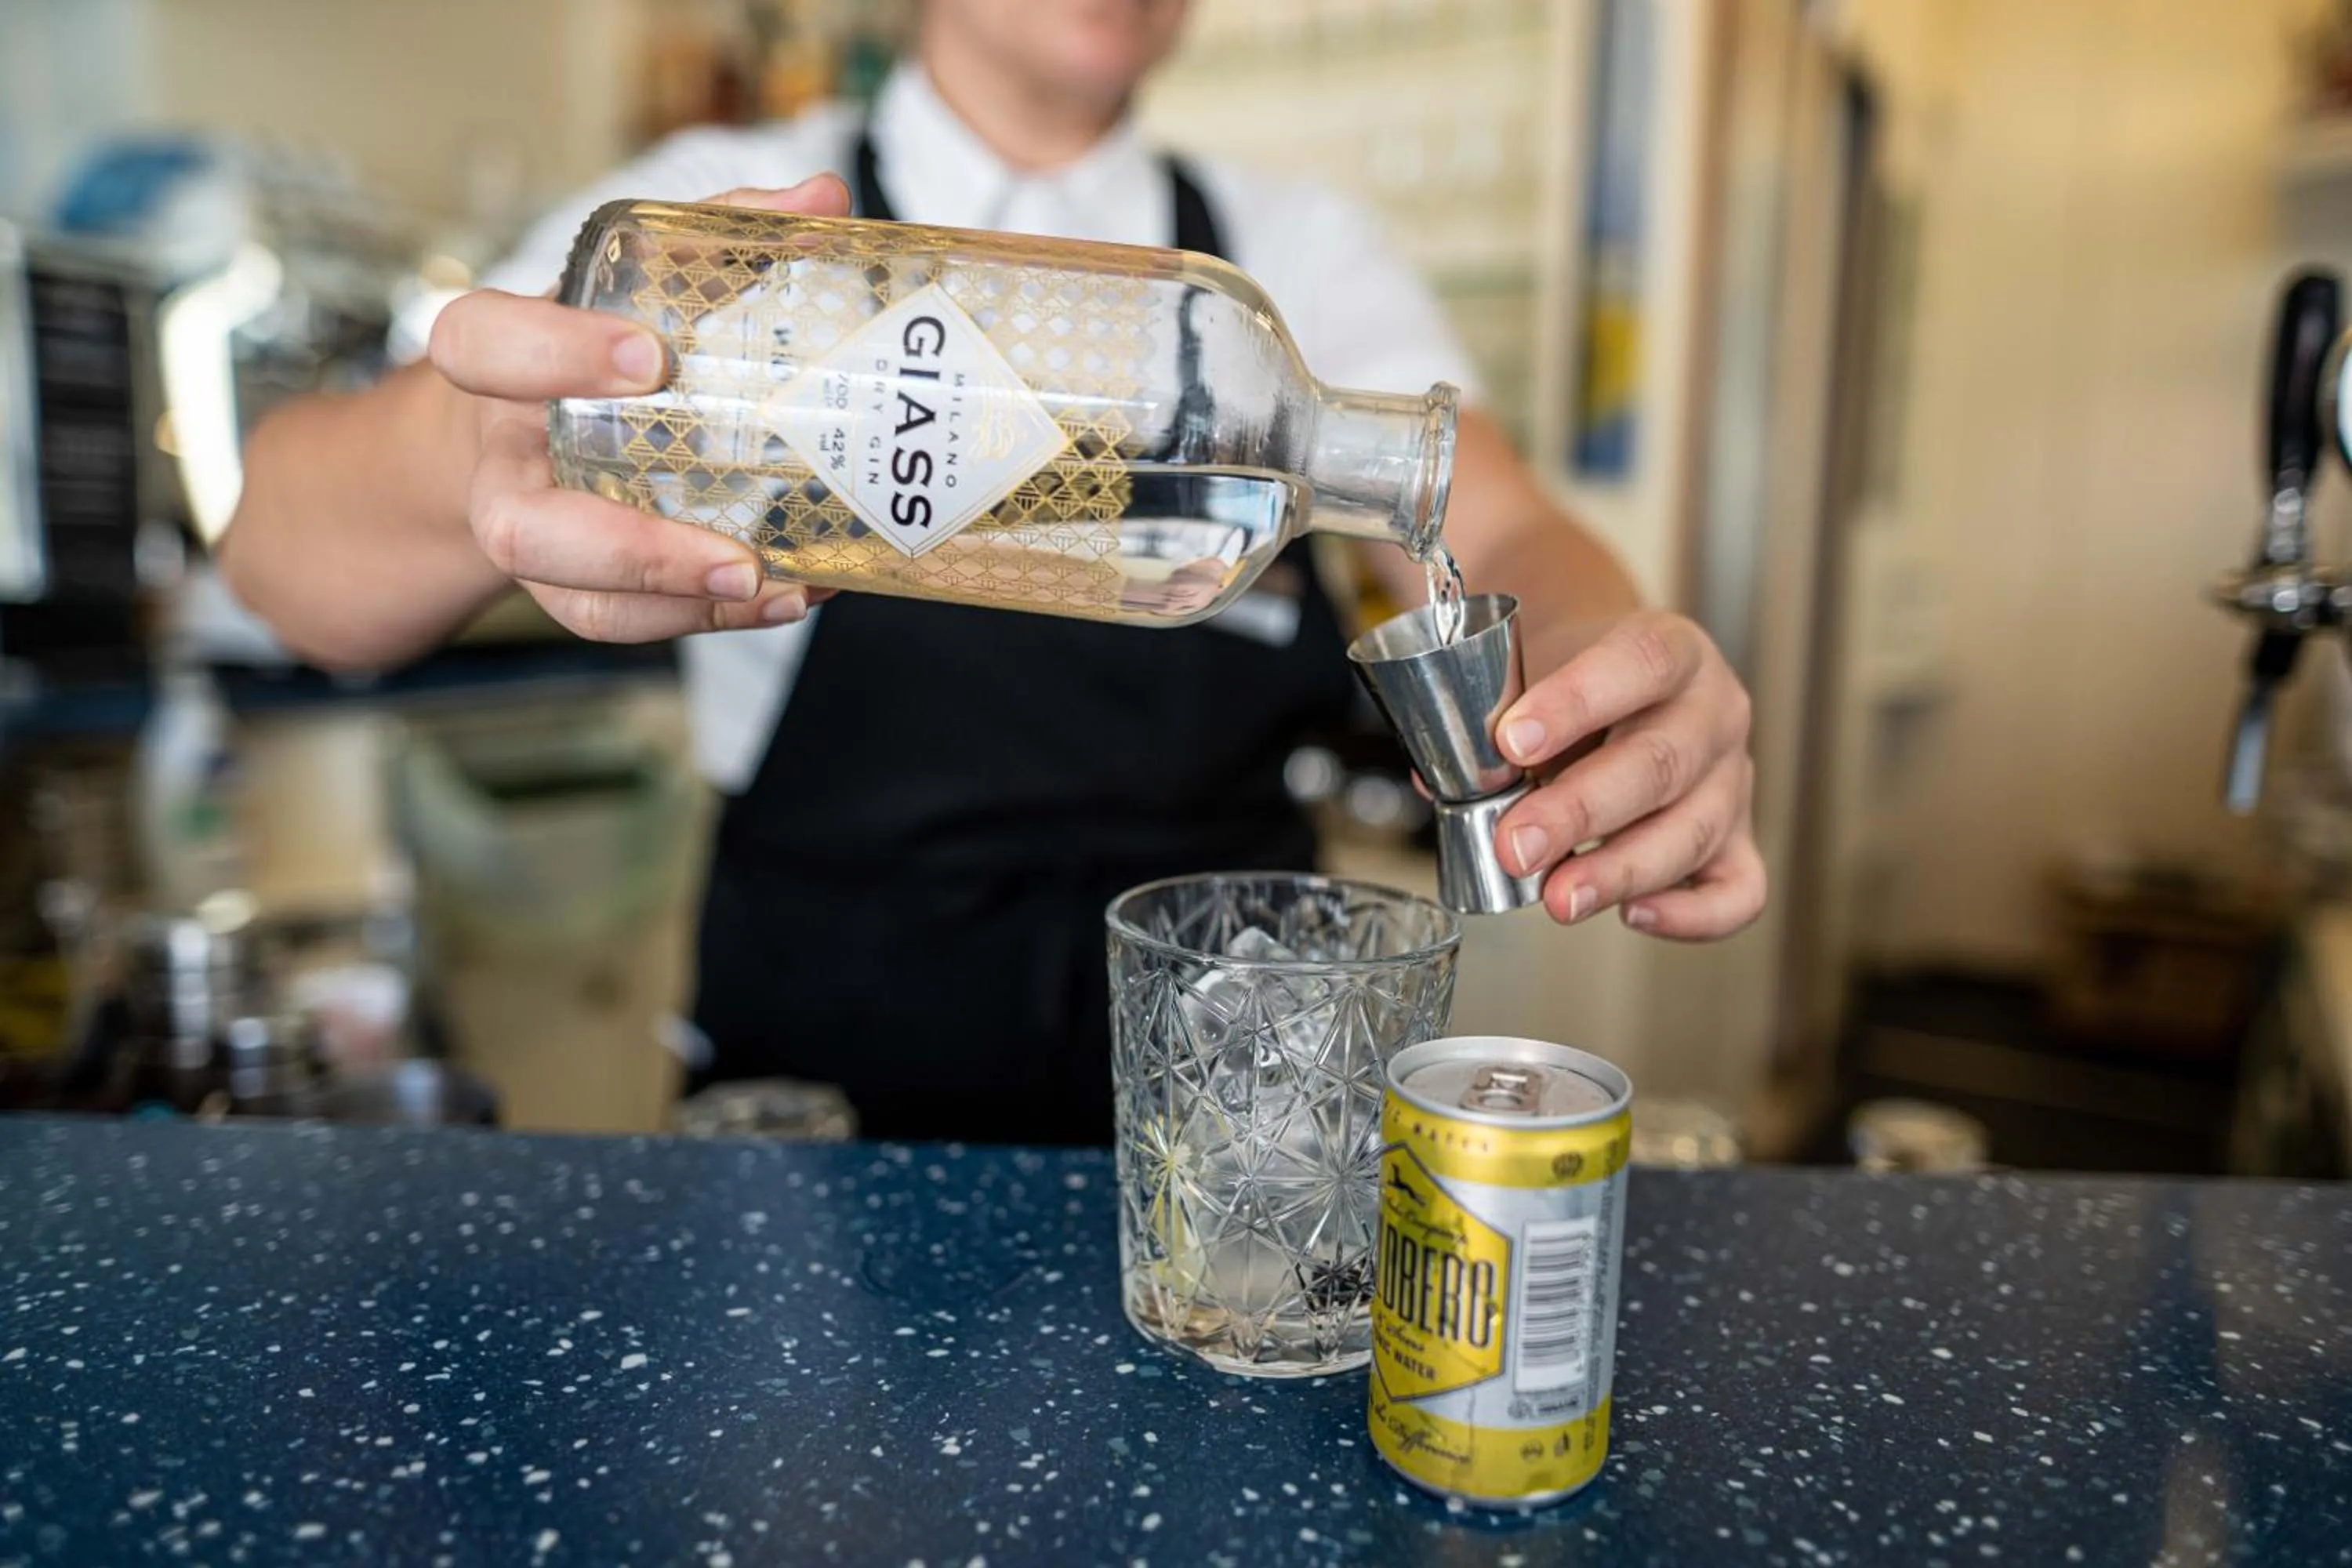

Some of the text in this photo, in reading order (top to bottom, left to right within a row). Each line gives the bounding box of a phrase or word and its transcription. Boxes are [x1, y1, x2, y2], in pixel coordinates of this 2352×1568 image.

[829, 427, 846, 470] 42%
[867, 436, 881, 485] GIN
[890, 315, 946, 530] GIASS
[945, 372, 966, 488] MILANO
